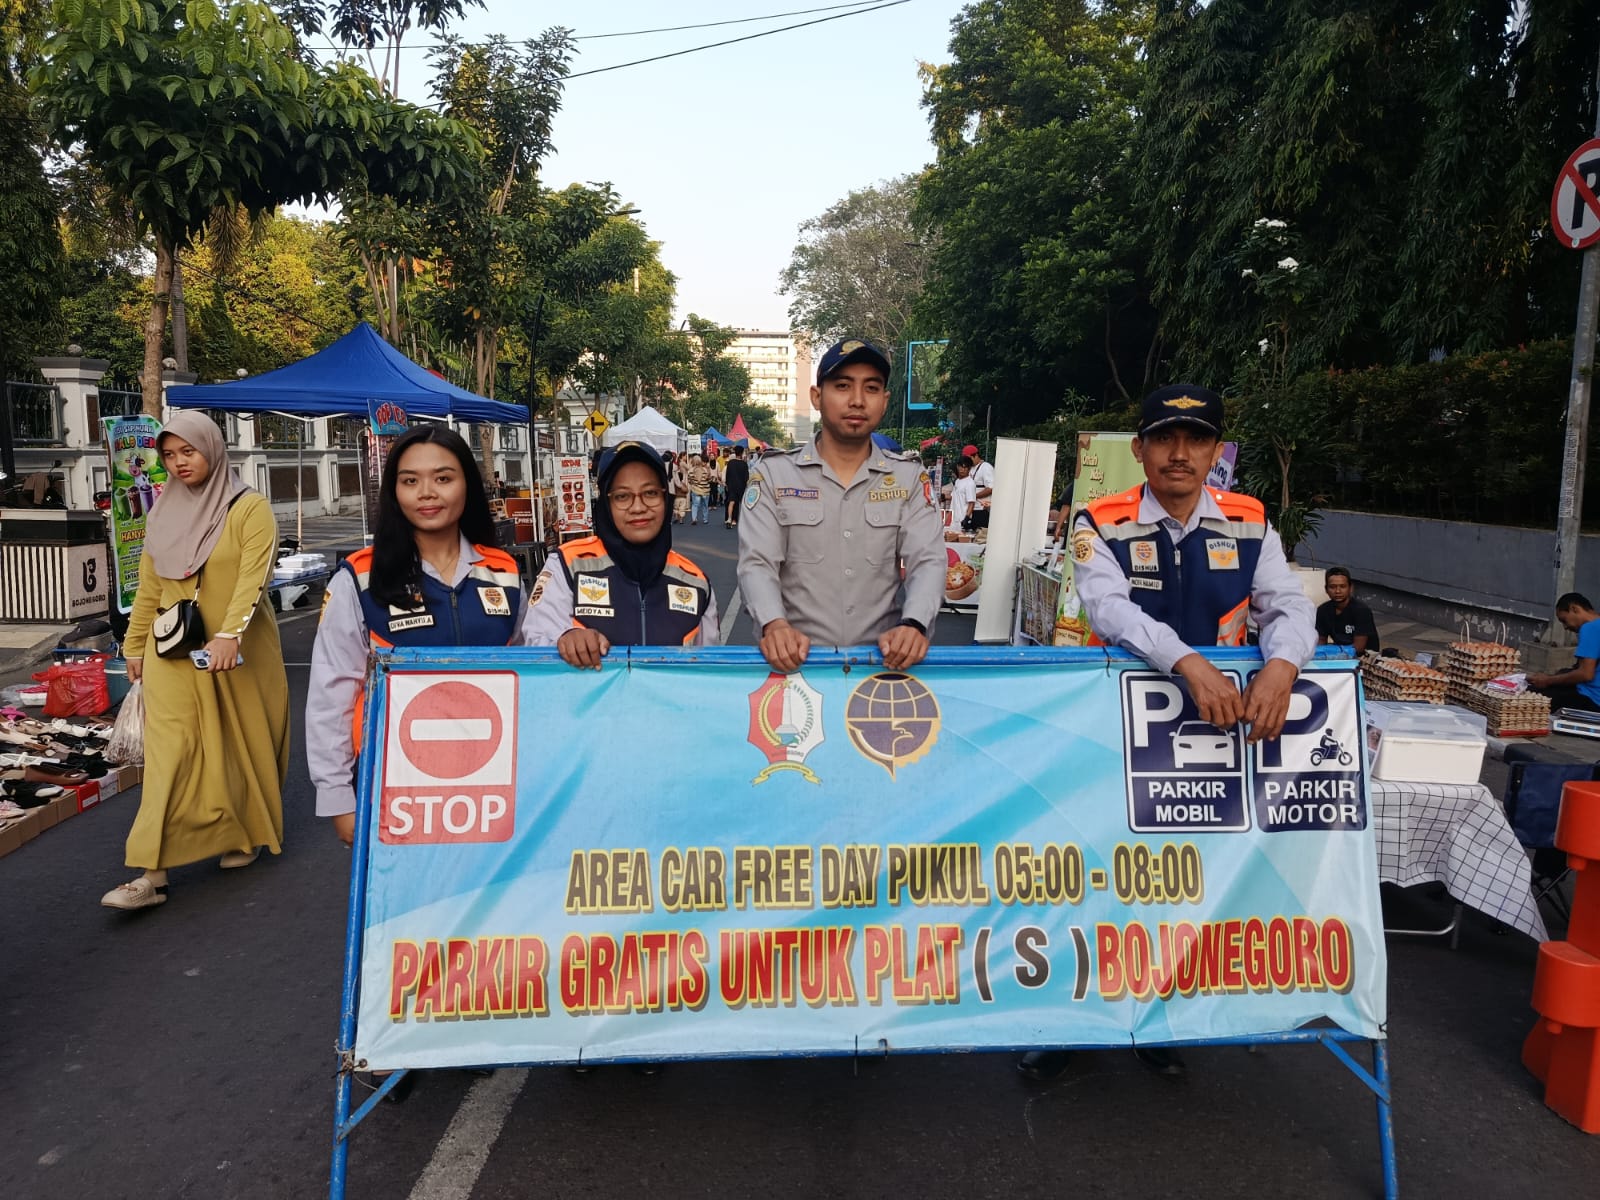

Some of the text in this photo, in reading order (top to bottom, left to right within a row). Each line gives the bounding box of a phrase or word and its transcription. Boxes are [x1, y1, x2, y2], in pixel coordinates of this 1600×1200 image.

[870, 490, 907, 501] DISHUB
[121, 529, 146, 543] HANYA
[1209, 541, 1236, 550] DISHUB
[580, 578, 607, 588] DISHUB
[72, 594, 106, 607] BOJONEGORO
[672, 602, 695, 612] DISHUB
[576, 607, 602, 615] MEIDYA
[1130, 680, 1184, 748] P
[1261, 678, 1329, 767] P
[1148, 780, 1227, 799] PARKIR
[1265, 779, 1357, 801] PARKIR
[388, 794, 507, 836] STOP
[1155, 804, 1222, 823] MOBIL
[1268, 803, 1358, 825] MOTOR
[566, 848, 652, 911] AREA
[660, 846, 726, 910] CAR
[734, 845, 814, 909] FREE
[820, 844, 880, 907] DAY
[888, 844, 989, 904] PUKUL
[994, 842, 1084, 904] 05:00
[1114, 842, 1203, 904] 08:00
[389, 935, 549, 1020] PARKIR
[560, 928, 708, 1014] GRATIS
[719, 925, 855, 1008] UNTUK
[863, 923, 963, 1005] PLAT
[1095, 917, 1354, 1001] BOJONEGORO
